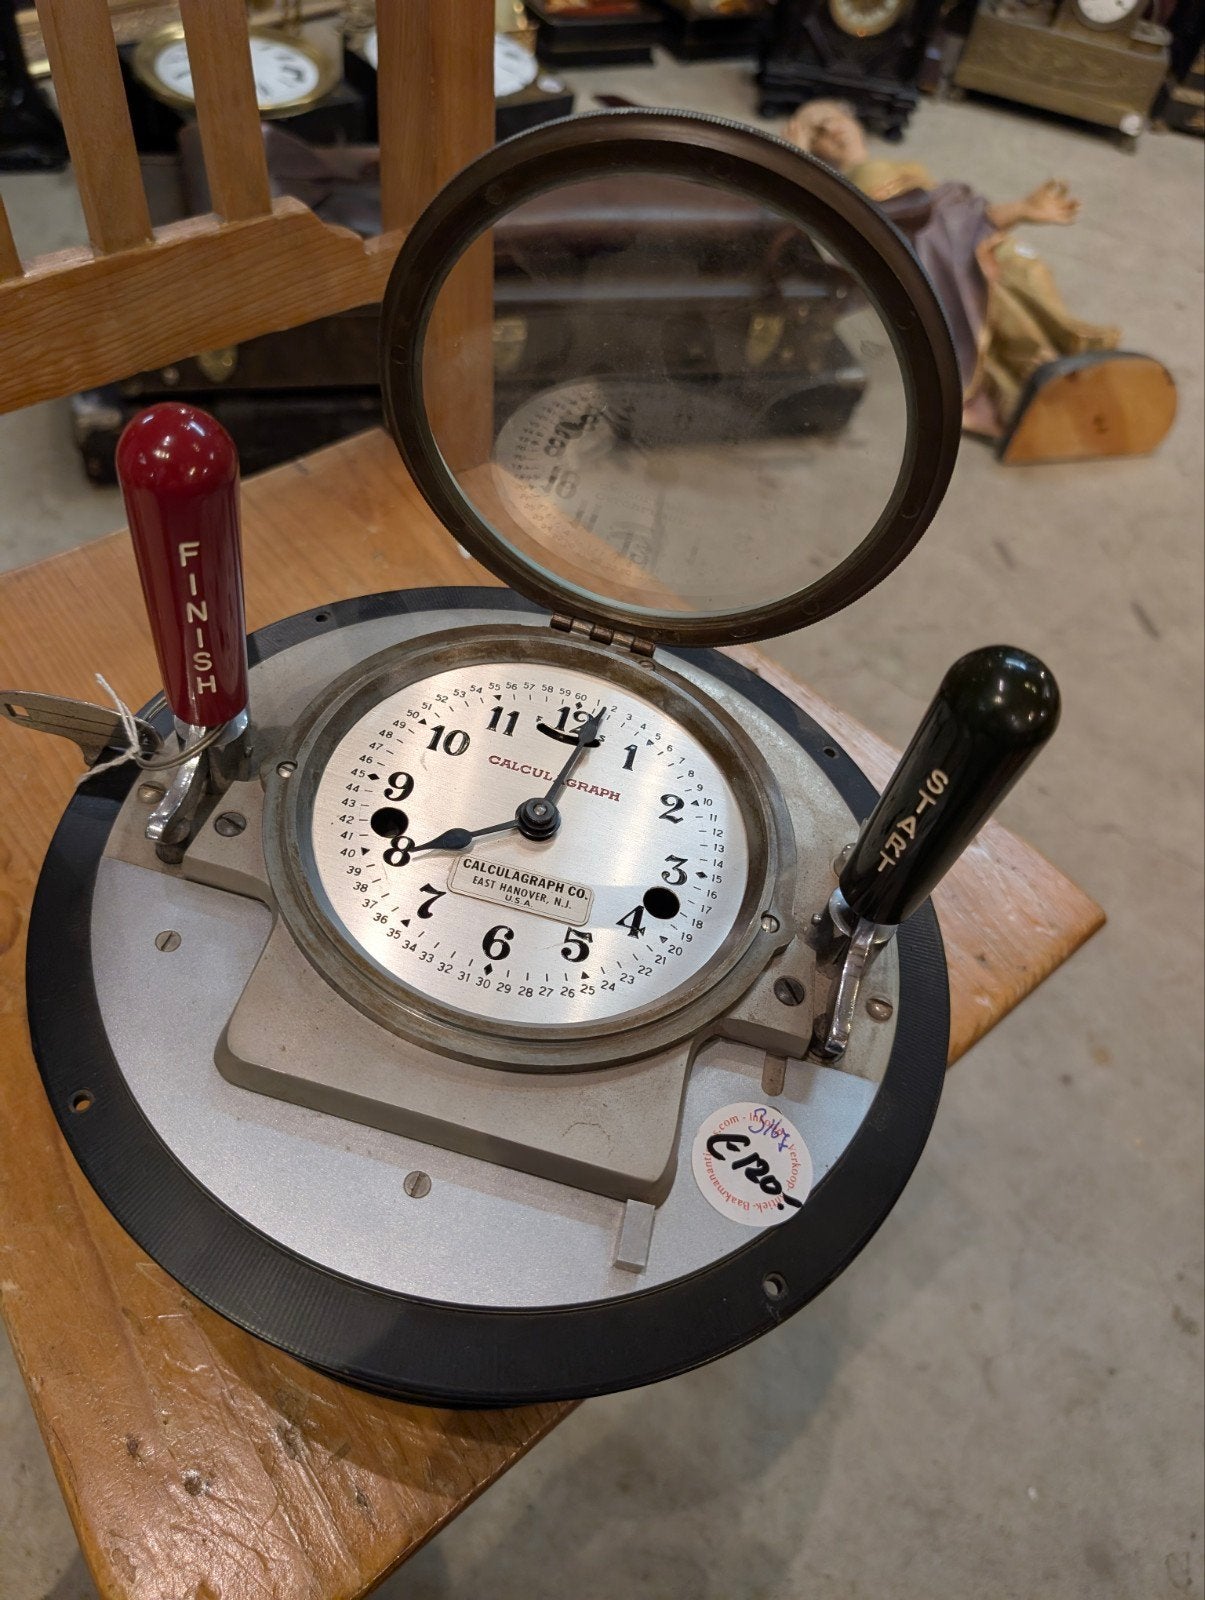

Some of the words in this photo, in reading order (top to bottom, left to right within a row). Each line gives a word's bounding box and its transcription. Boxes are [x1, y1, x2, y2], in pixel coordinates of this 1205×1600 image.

[178, 541, 217, 695] FINISH
[469, 684, 483, 694] 54
[488, 682, 501, 691] 55
[505, 681, 518, 691] 56
[523, 681, 536, 691] 57
[541, 684, 554, 694] 58
[453, 688, 467, 698] 53
[559, 687, 571, 697] 59
[575, 692, 588, 702] 60
[435, 694, 449, 703] 52
[421, 702, 433, 711] 51
[406, 709, 419, 719] 50
[626, 713, 633, 721] 3
[392, 720, 406, 729] 49
[485, 705, 520, 737] 11
[378, 729, 393, 738] 48
[426, 724, 471, 757] 10
[369, 742, 384, 751] 47
[359, 755, 373, 764] 46
[622, 744, 638, 771] 1
[351, 768, 366, 778] 45
[687, 770, 695, 778] 8
[346, 783, 360, 793] 44
[383, 771, 415, 802] 9
[696, 784, 704, 792] 9
[341, 798, 356, 808] 43
[703, 798, 713, 806] 10
[658, 793, 685, 824] 2
[339, 814, 355, 825] 42
[709, 813, 718, 822] 11
[877, 768, 949, 873] START
[340, 831, 354, 840] 41
[712, 828, 724, 838] 12
[340, 848, 356, 858] 40
[383, 835, 415, 867] 8
[714, 843, 725, 853] 13
[713, 859, 724, 868] 14
[346, 866, 362, 876] 39
[661, 854, 688, 886] 3
[463, 858, 565, 893] CALCULAGRAPH
[568, 886, 589, 900] CO.
[711, 874, 722, 884] 15
[352, 881, 369, 893] 38
[472, 875, 496, 889] EAST
[500, 882, 549, 905] HANOVER,
[554, 897, 572, 910] N.J.
[706, 890, 718, 900] 16
[361, 899, 379, 909] 37
[417, 883, 447, 919] 7
[701, 904, 712, 914] 17
[373, 912, 389, 924] 36
[615, 904, 646, 939] 4
[691, 918, 704, 929] 18
[386, 928, 402, 940] 35
[681, 932, 693, 942] 19
[402, 940, 418, 952] 34
[482, 925, 515, 961] 6
[561, 926, 593, 963] 5
[667, 945, 683, 956] 20
[418, 951, 434, 963] 33
[655, 955, 666, 965] 21
[437, 962, 453, 974] 32
[637, 965, 653, 977] 22
[457, 971, 470, 983] 31
[620, 973, 635, 985] 23
[475, 976, 491, 989] 30
[600, 980, 616, 991] 24
[496, 982, 512, 994] 29
[518, 986, 534, 998] 28
[538, 986, 554, 997] 27
[560, 986, 575, 998] 26
[580, 984, 595, 995] 25
